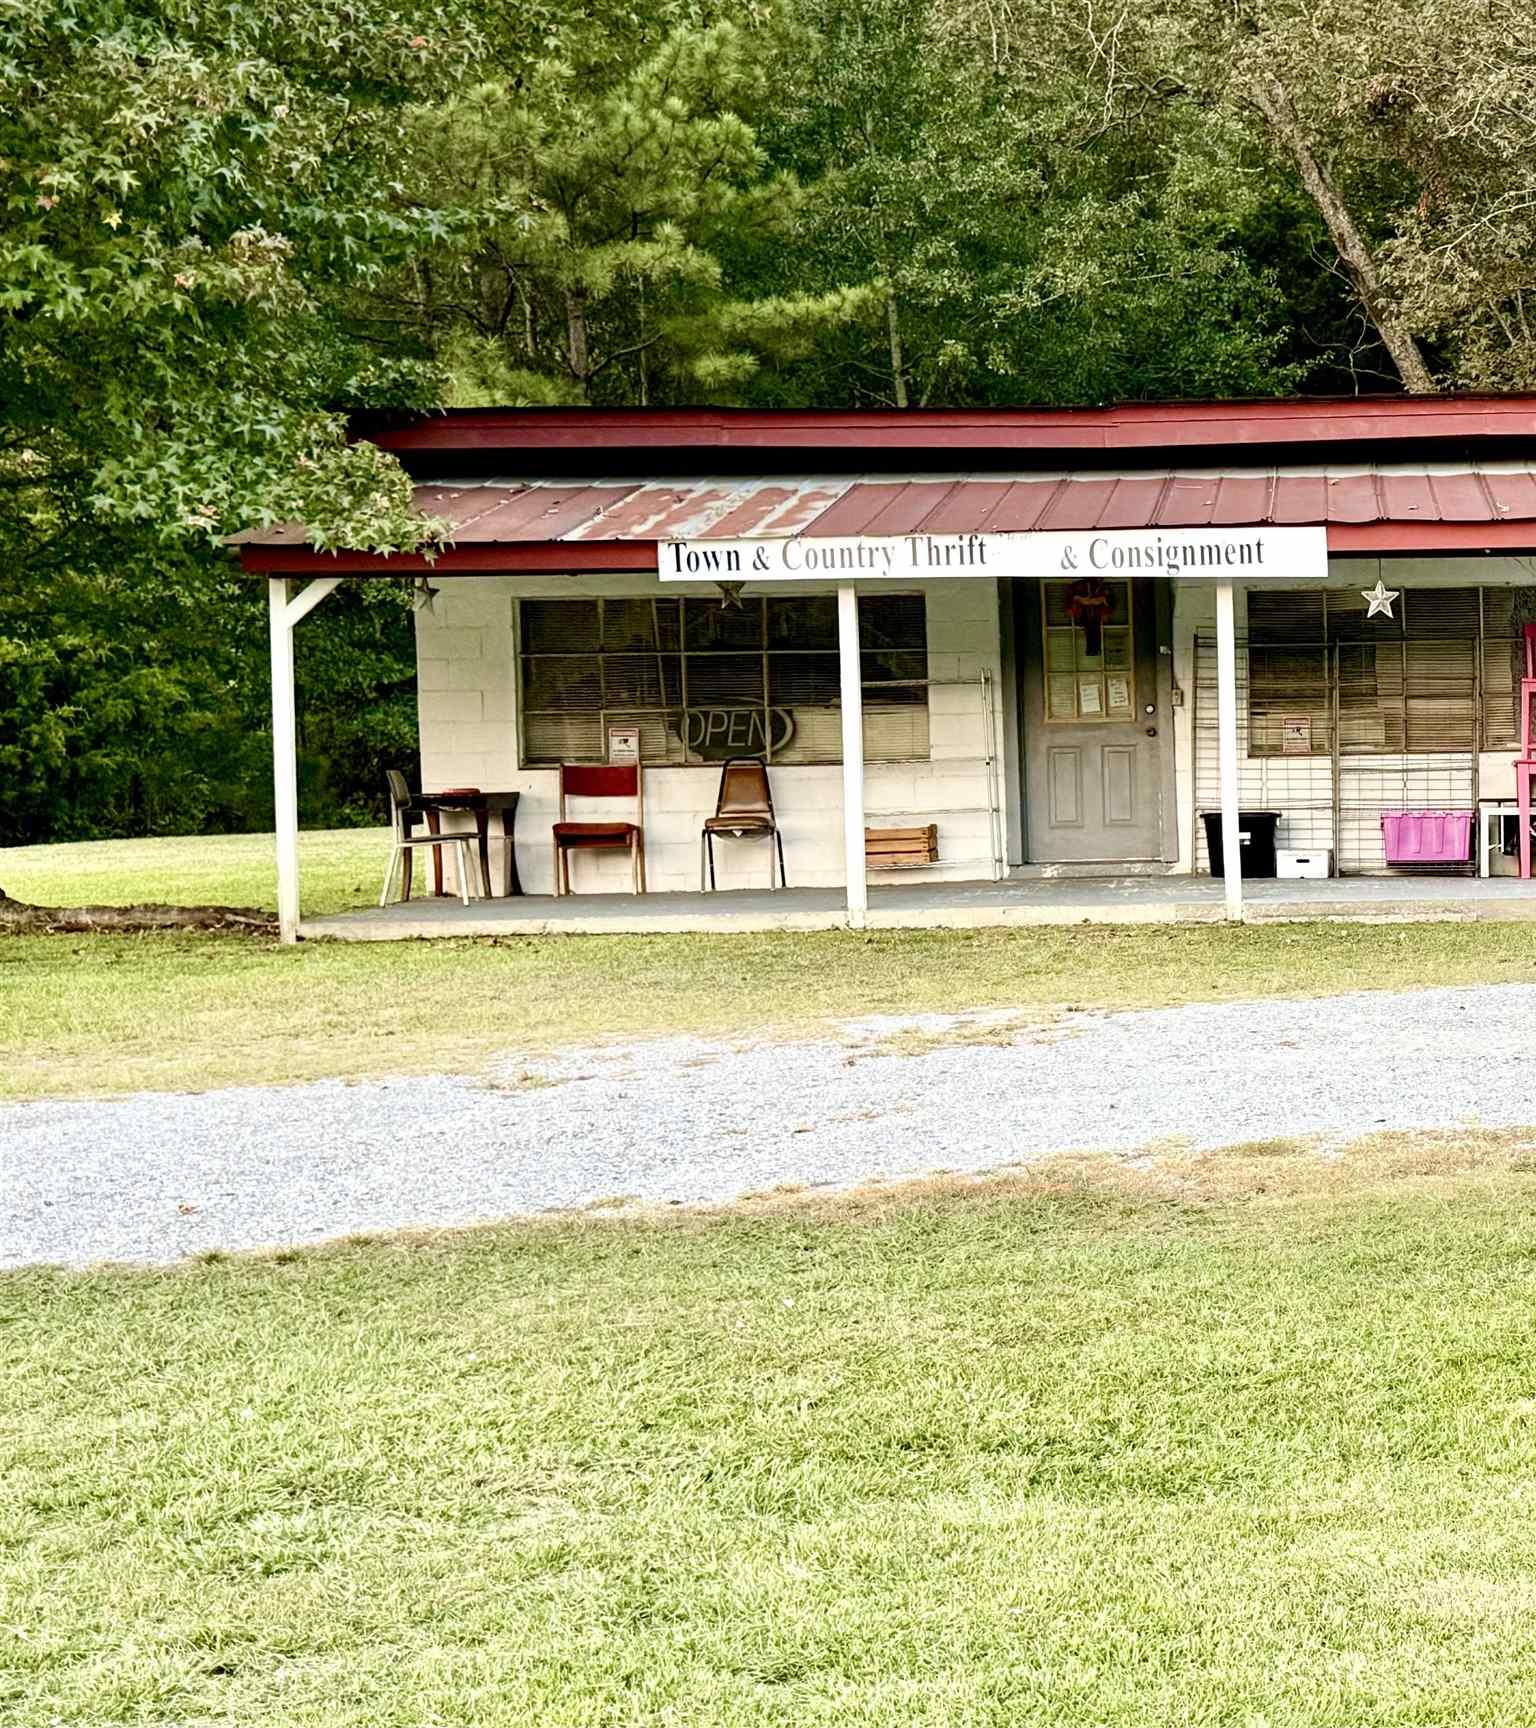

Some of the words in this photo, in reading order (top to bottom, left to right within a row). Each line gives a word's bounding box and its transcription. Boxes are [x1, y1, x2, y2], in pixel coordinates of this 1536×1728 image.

[668, 541, 741, 573] Town
[752, 545, 771, 571] &
[782, 538, 896, 576] Country
[905, 534, 987, 568] Thrift
[1060, 545, 1079, 571] &
[1089, 536, 1265, 576] Consignment
[681, 710, 770, 747] OPEN
